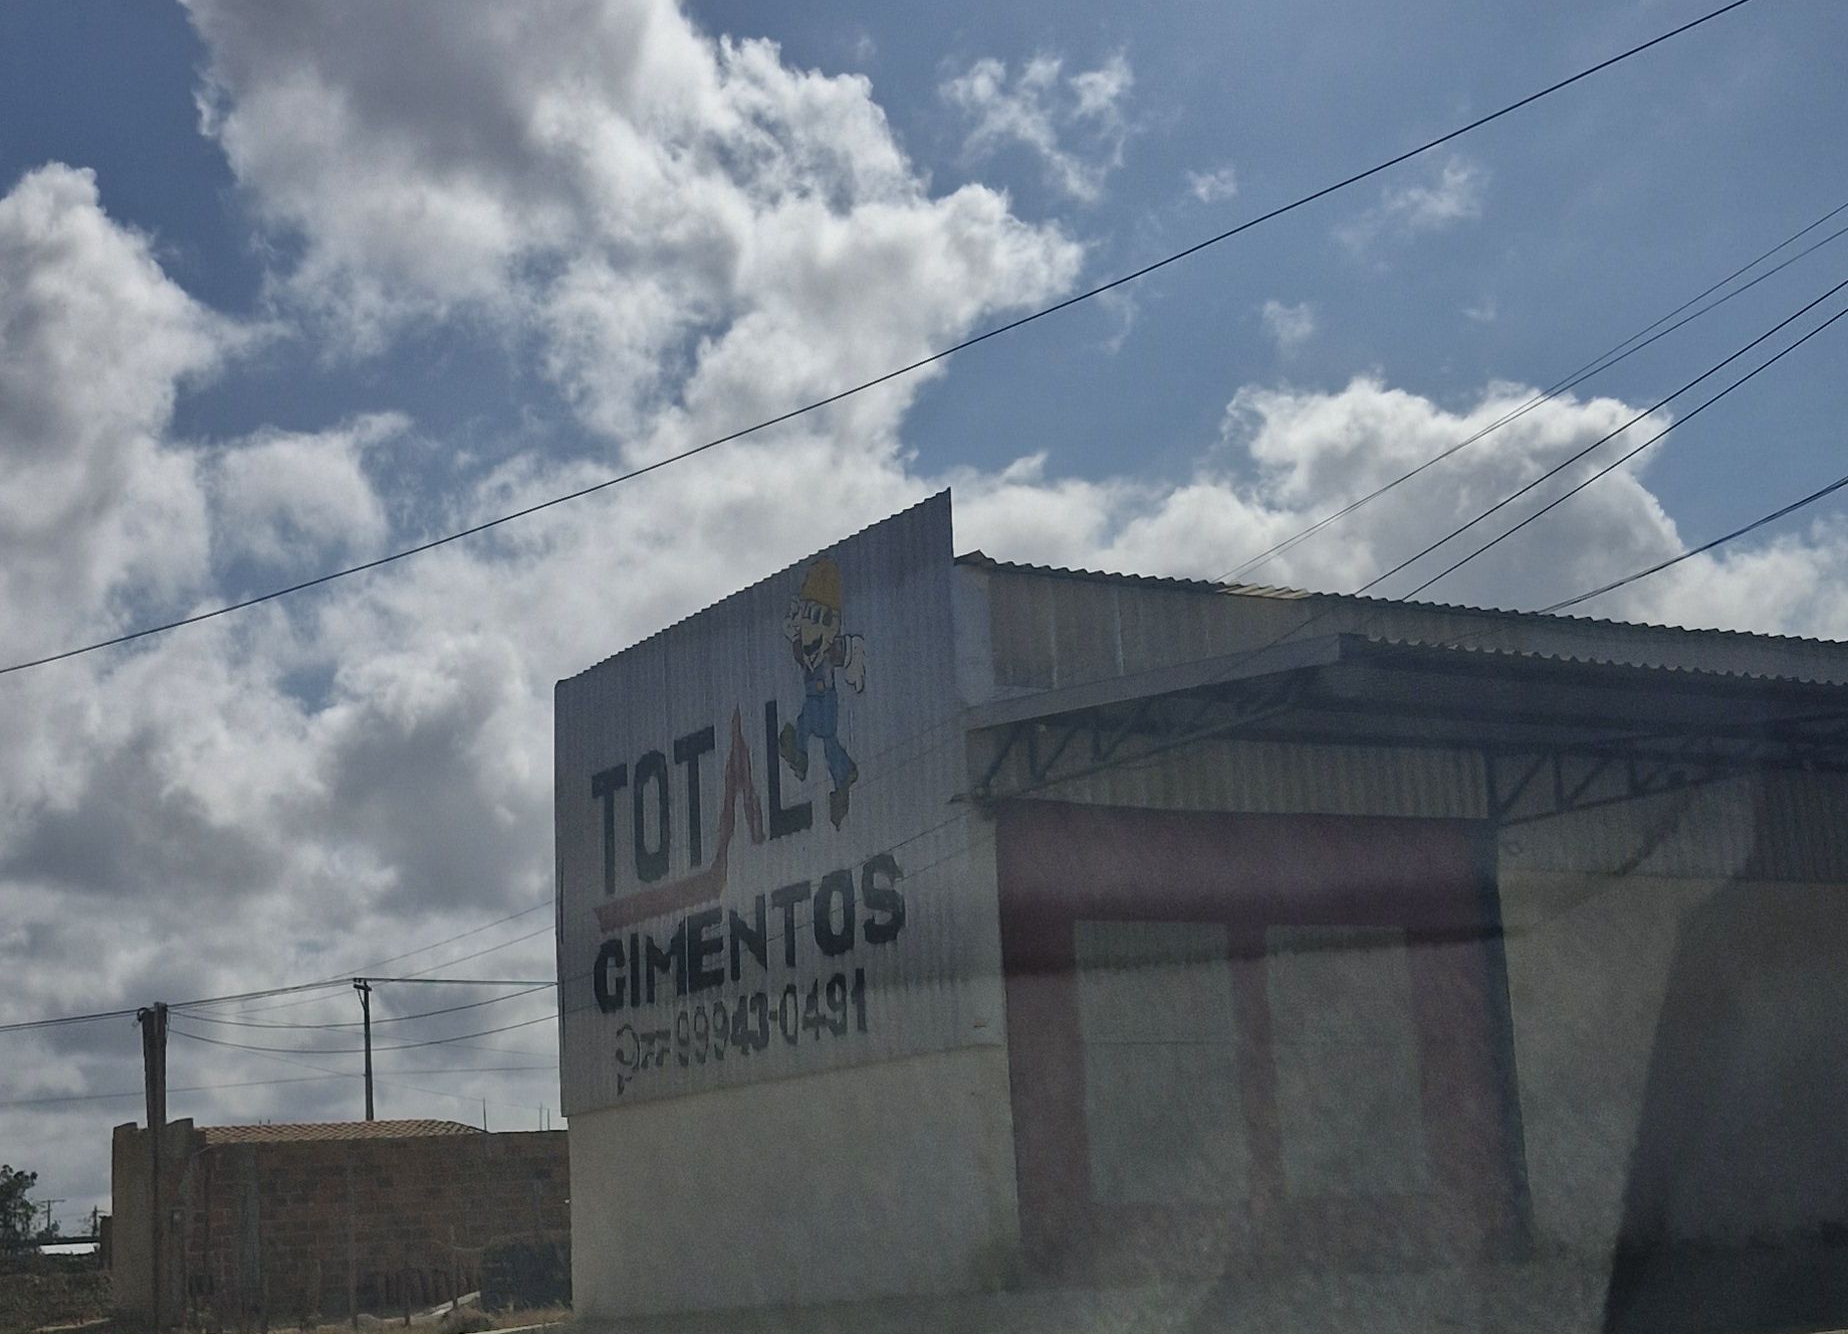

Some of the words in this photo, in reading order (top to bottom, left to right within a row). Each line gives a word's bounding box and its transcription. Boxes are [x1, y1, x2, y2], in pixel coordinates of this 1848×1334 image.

[591, 699, 813, 896] TOTAL
[593, 853, 906, 1015] CIMENTOS
[676, 966, 868, 1068] 99943-0491
